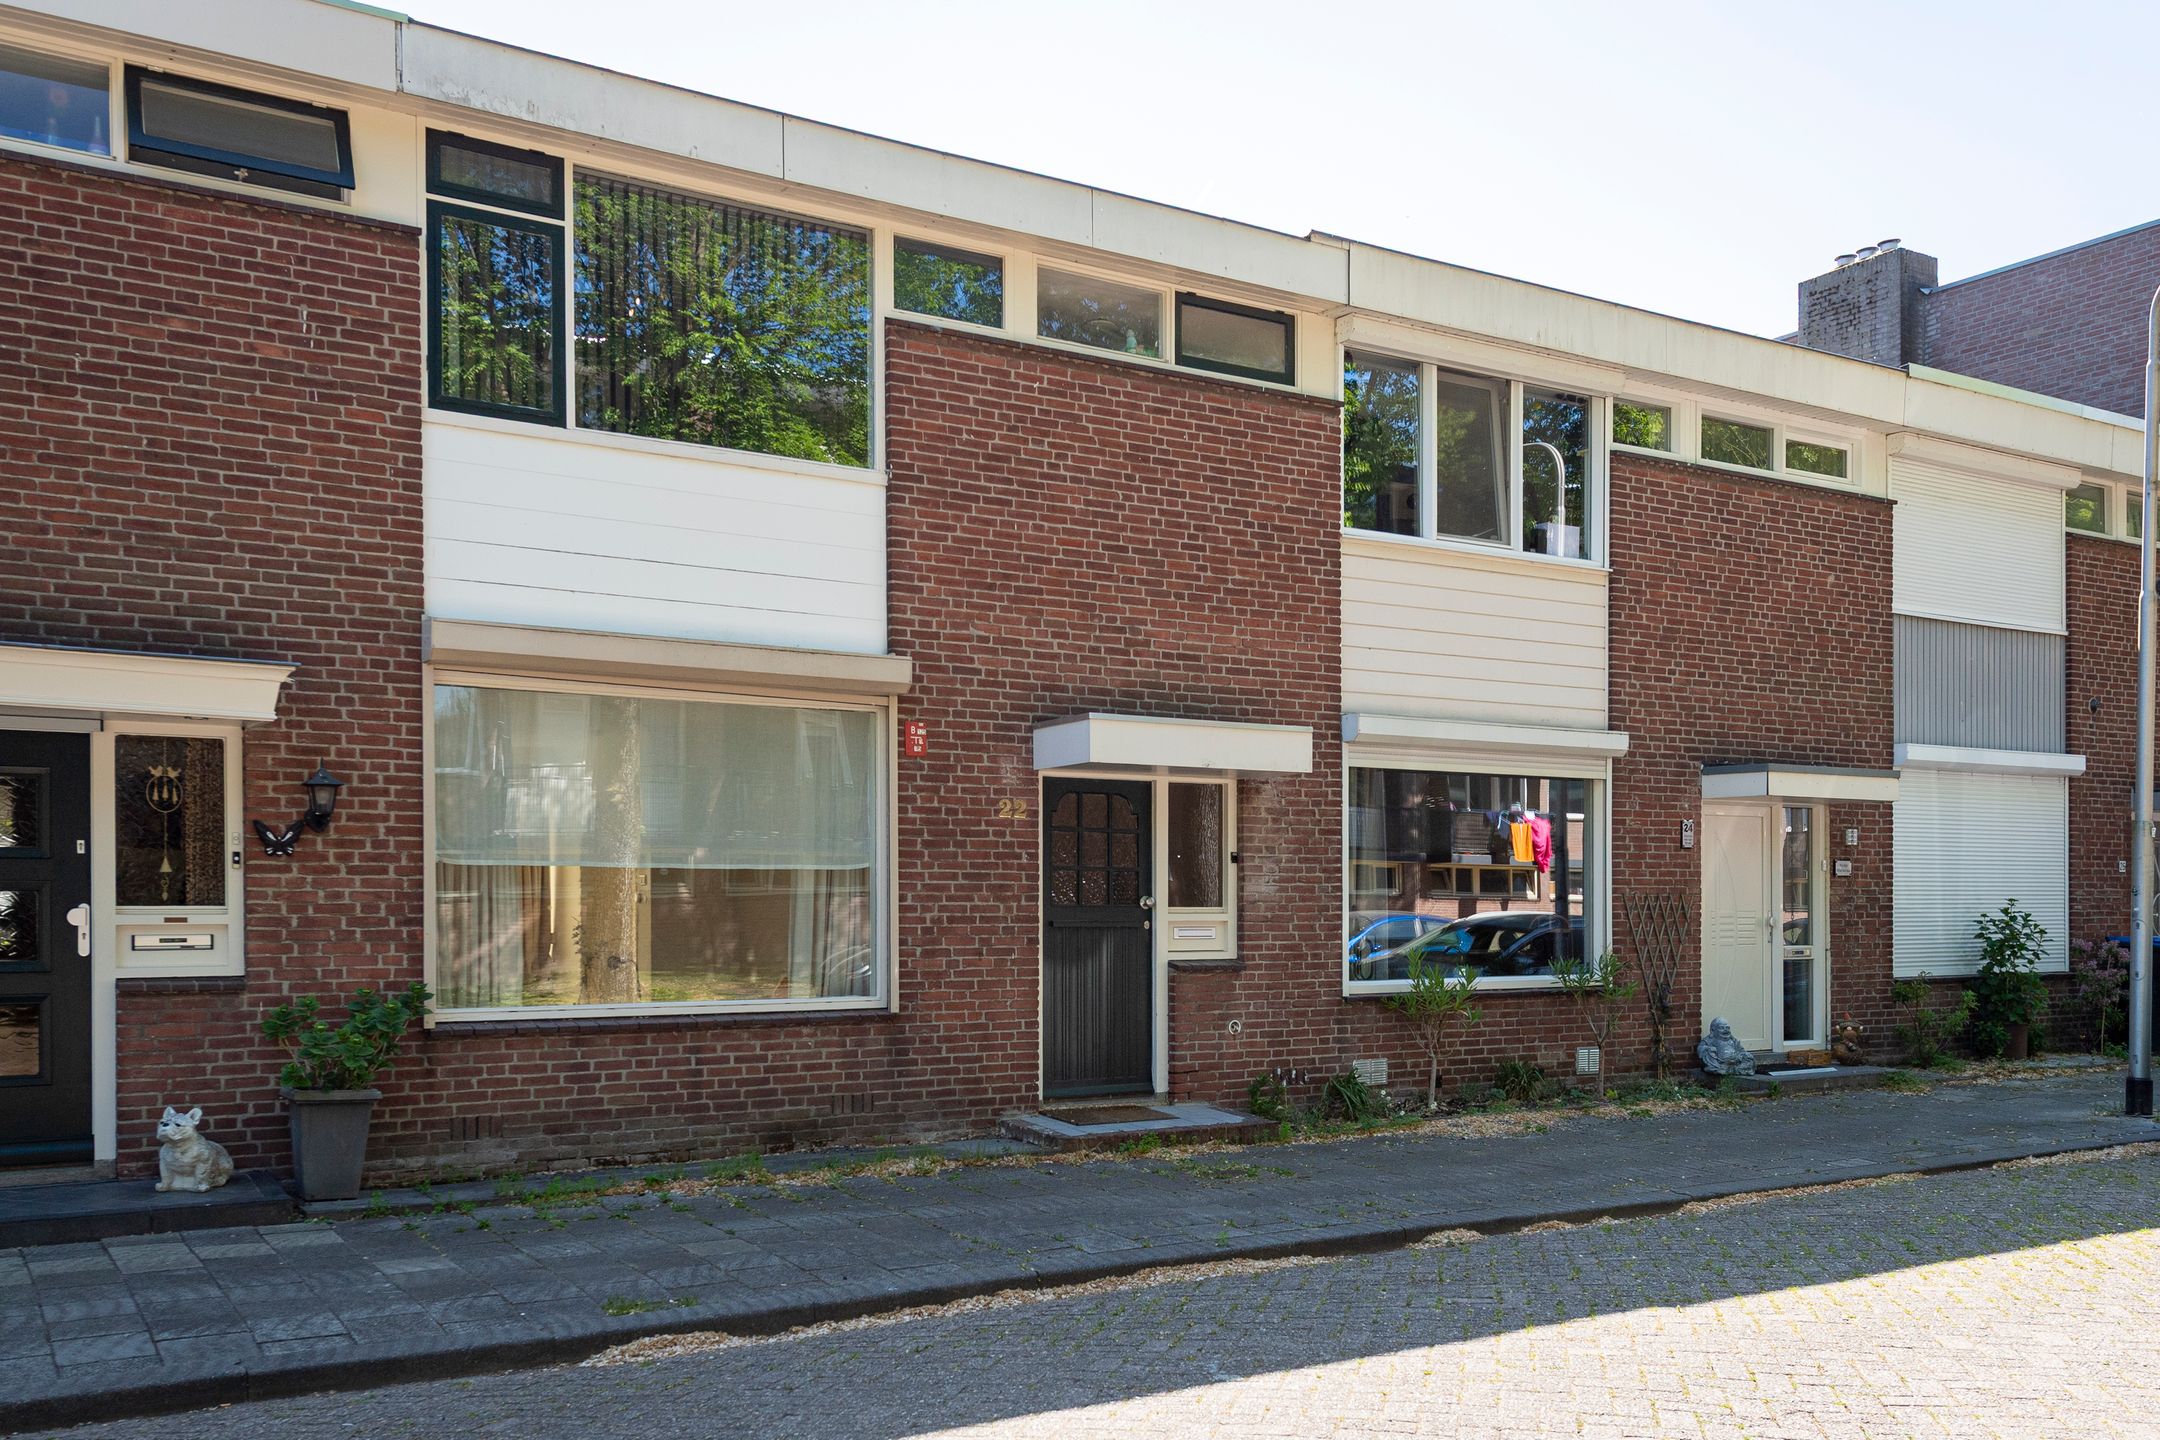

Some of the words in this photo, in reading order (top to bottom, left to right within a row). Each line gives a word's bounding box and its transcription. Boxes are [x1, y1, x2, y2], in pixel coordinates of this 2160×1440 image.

[911, 726, 915, 734] B
[999, 799, 1027, 818] 22
[1684, 824, 1693, 833] 24
